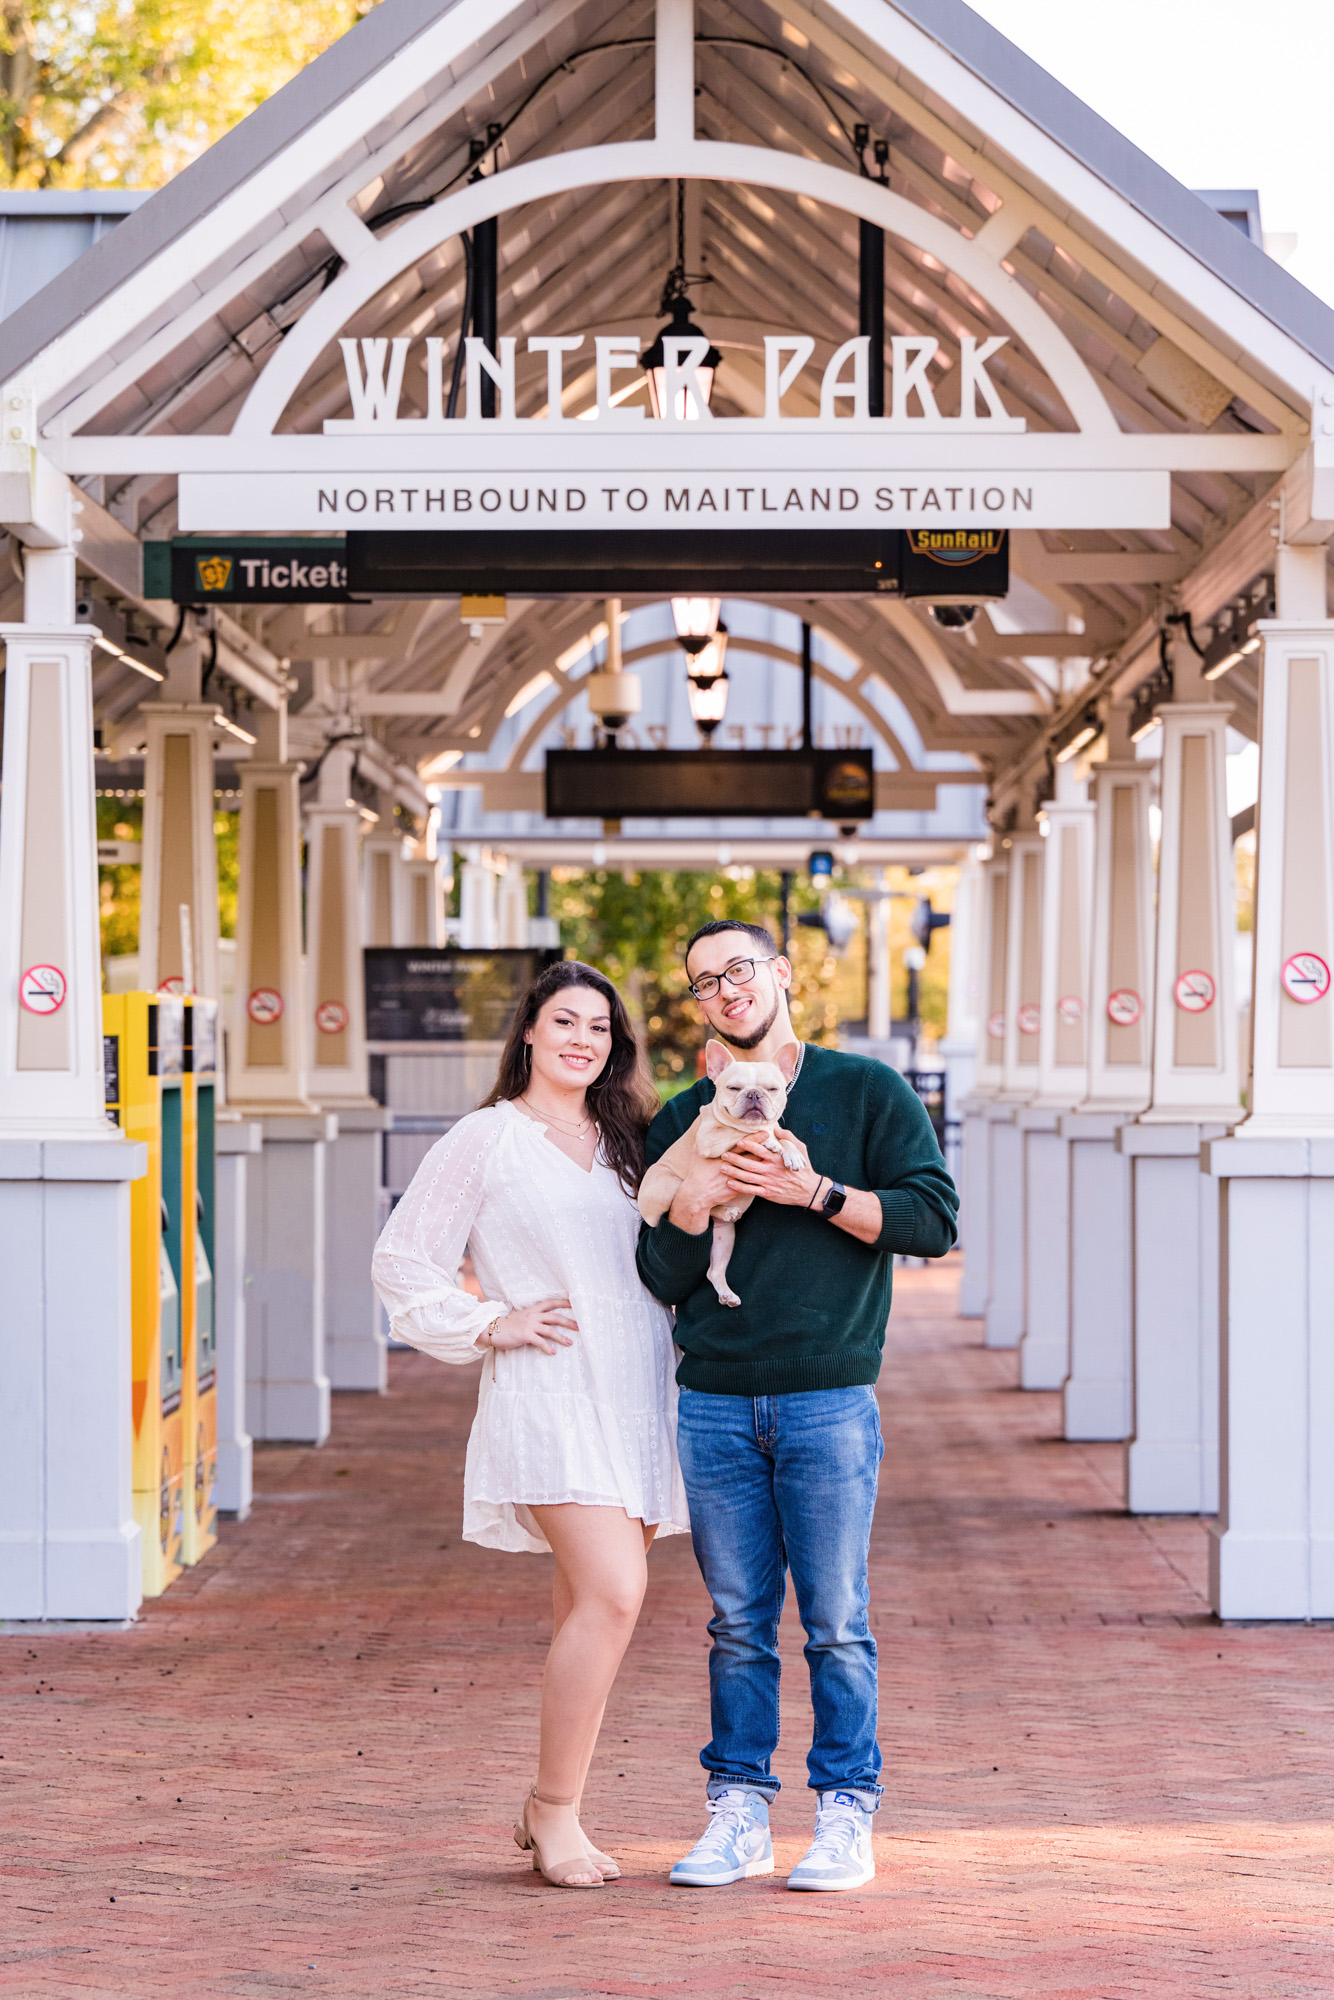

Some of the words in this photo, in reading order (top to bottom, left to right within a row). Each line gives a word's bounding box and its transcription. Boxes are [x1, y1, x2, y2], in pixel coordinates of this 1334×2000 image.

[338, 335, 714, 420] WINTER
[763, 335, 1010, 419] PARK
[318, 488, 587, 512] NORTHBOUND
[601, 488, 648, 512] TO
[665, 488, 860, 511] MAITLAND
[875, 487, 1032, 511] STATION
[917, 530, 994, 549] SunRail
